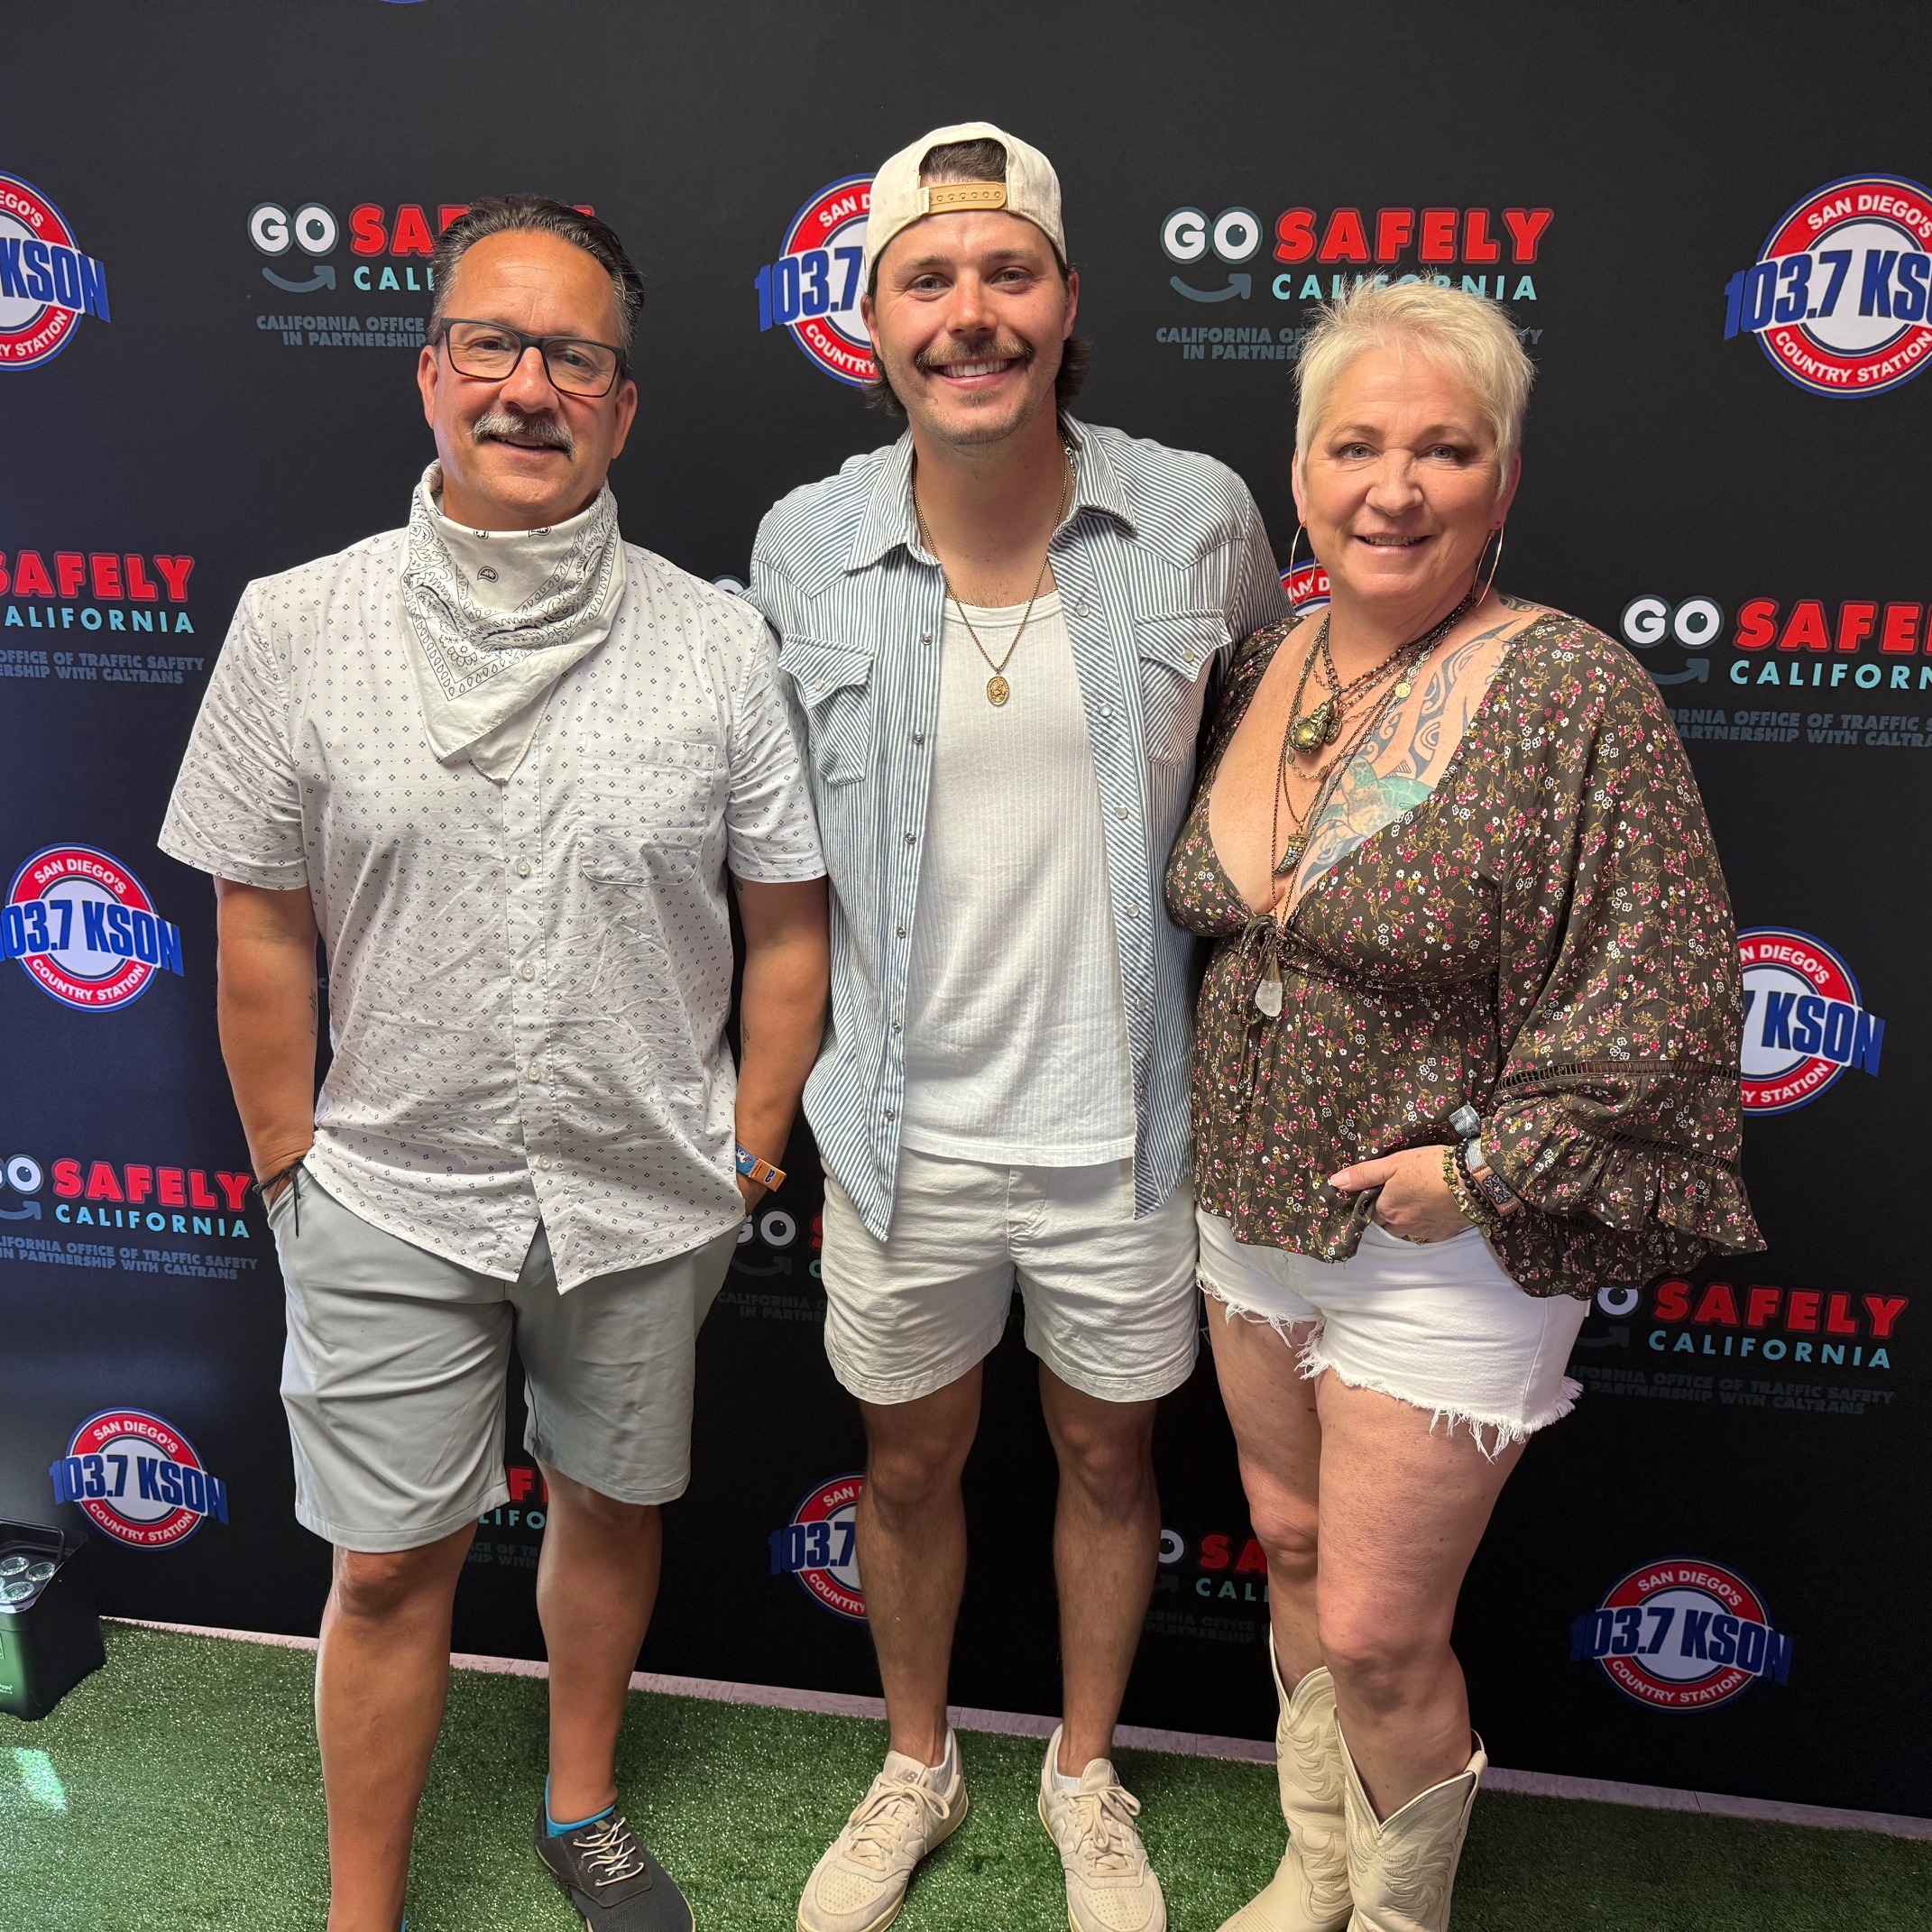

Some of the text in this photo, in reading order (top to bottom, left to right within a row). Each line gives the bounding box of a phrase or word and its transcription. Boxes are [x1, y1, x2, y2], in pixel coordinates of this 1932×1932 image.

[251, 206, 336, 253] GO
[819, 196, 857, 227] SAN
[1808, 195, 1932, 238] SAN DIEGO'S
[1164, 211, 1550, 261] GO SAFELY
[0, 236, 110, 323] KSON
[754, 245, 863, 332] 103.7
[1724, 249, 1932, 341] 103.7 KS
[16, 310, 68, 356] STATION
[256, 316, 425, 332] CALIFORNIA OFFICE
[282, 331, 427, 348] IN PARTNERSHIP
[1155, 327, 1272, 344] CALIFORNIA
[805, 324, 876, 373] COUNTRY
[1183, 345, 1204, 360] IN
[1776, 330, 1932, 382] COUNTRY STATION
[5, 606, 195, 633] ALIFORNIA
[1624, 598, 1932, 652] GO SAFE
[52, 651, 74, 666] OF
[78, 653, 142, 668] TRAFFIC
[147, 656, 205, 671] SAFETY
[55, 667, 97, 681] WITH
[103, 668, 184, 685] CALTRANS
[1734, 711, 1800, 728] OFFICE
[1807, 713, 1833, 729] OF
[1840, 713, 1919, 731] TRAFFIC
[1807, 729, 1857, 745] WITH
[33, 858, 127, 895] SAN DIEGO'S
[82, 900, 184, 977] KSON
[32, 959, 145, 1000] COUNTRY STATION
[1760, 944, 1830, 984] DIEGO'S
[1762, 990, 1885, 1077] KSON
[1761, 1062, 1829, 1102] STATION
[53, 1160, 251, 1210] SAFELY
[55, 1204, 250, 1238] CALIFORNIA
[0, 1236, 258, 1270] IFORNIA OFFICE OF TRAFFIC SAFETY
[19, 1248, 116, 1269] PARTNERSHIP
[120, 1259, 159, 1274] WITH
[164, 1263, 238, 1280] CALTRANS
[1655, 1282, 1907, 1337] SAFELY
[1649, 1330, 1891, 1369] CALIFORNIA
[1652, 1373, 1714, 1390] OFFICE
[1720, 1378, 1743, 1392] OF
[1750, 1380, 1822, 1398] TRAFFIC
[1828, 1386, 1895, 1404] SAFETY
[93, 1421, 179, 1454] SAN DIEGO'S
[49, 1454, 229, 1525] 103.7 KSON
[823, 1486, 854, 1507] SAN
[90, 1503, 193, 1541] COUNTRY STATION
[768, 1522, 856, 1576] 103.7
[1638, 1570, 1743, 1606] SAN DIEGO'S
[1569, 1607, 1794, 1687] 103.7 KSON
[1612, 1661, 1743, 1703] COUNTRY STATION
